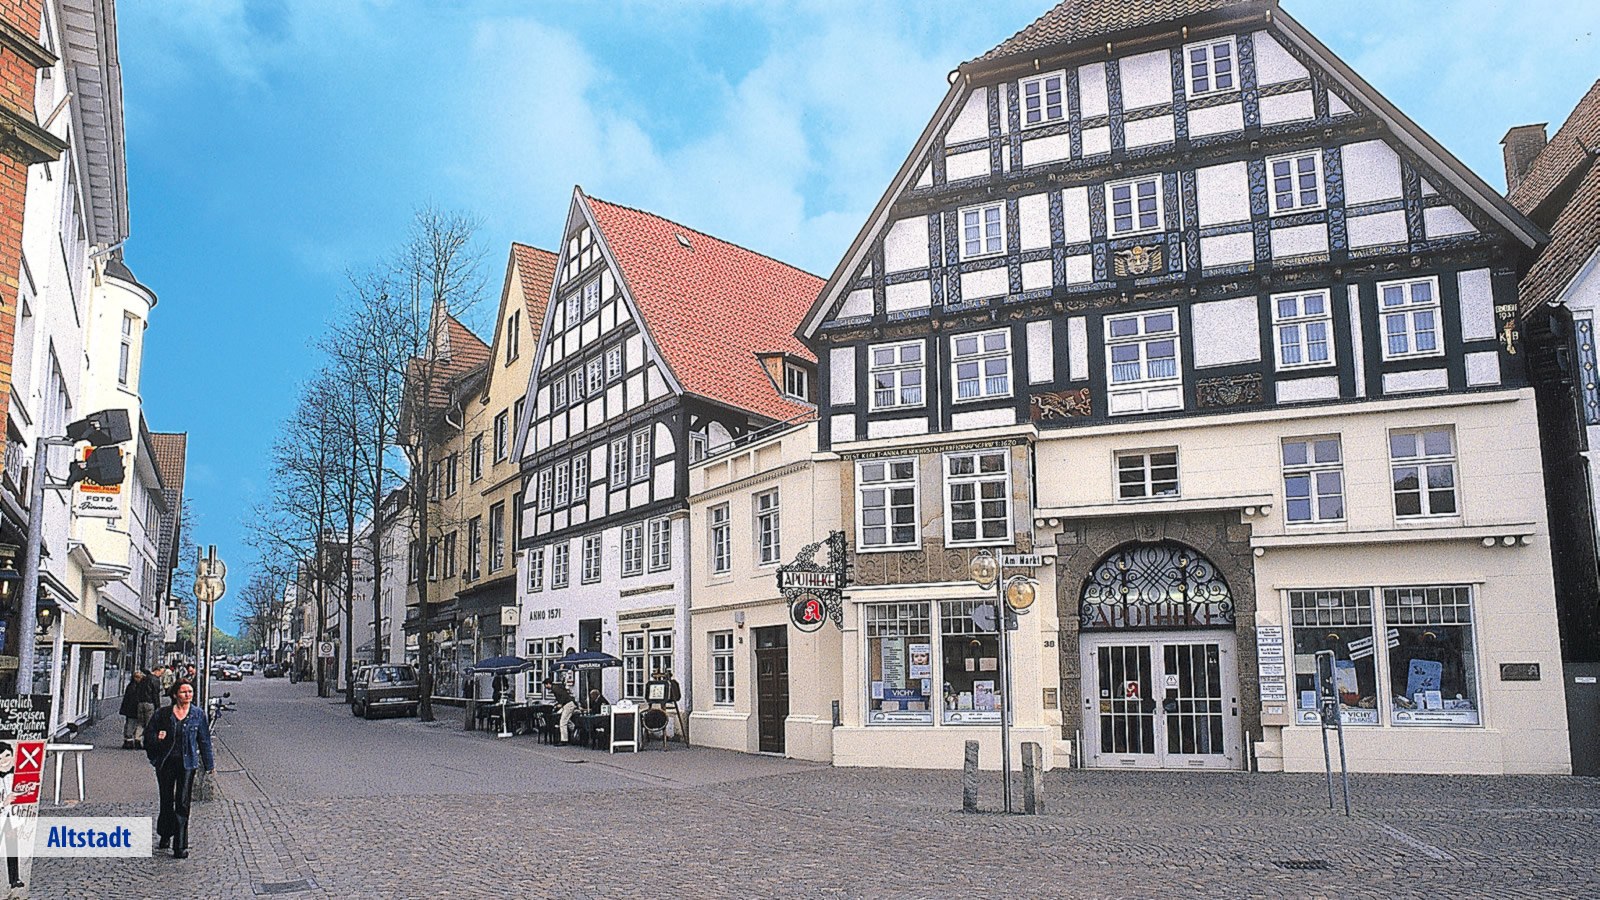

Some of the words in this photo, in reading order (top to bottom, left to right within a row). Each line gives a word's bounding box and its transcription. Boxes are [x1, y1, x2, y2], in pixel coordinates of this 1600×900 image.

[1004, 555, 1016, 565] Am
[1020, 555, 1040, 565] Markt
[784, 572, 834, 587] APOTHEKE
[529, 610, 546, 621] ANNO
[548, 608, 561, 619] 1571
[1091, 601, 1219, 627] APOTHEKE
[8, 708, 45, 724] Speisen
